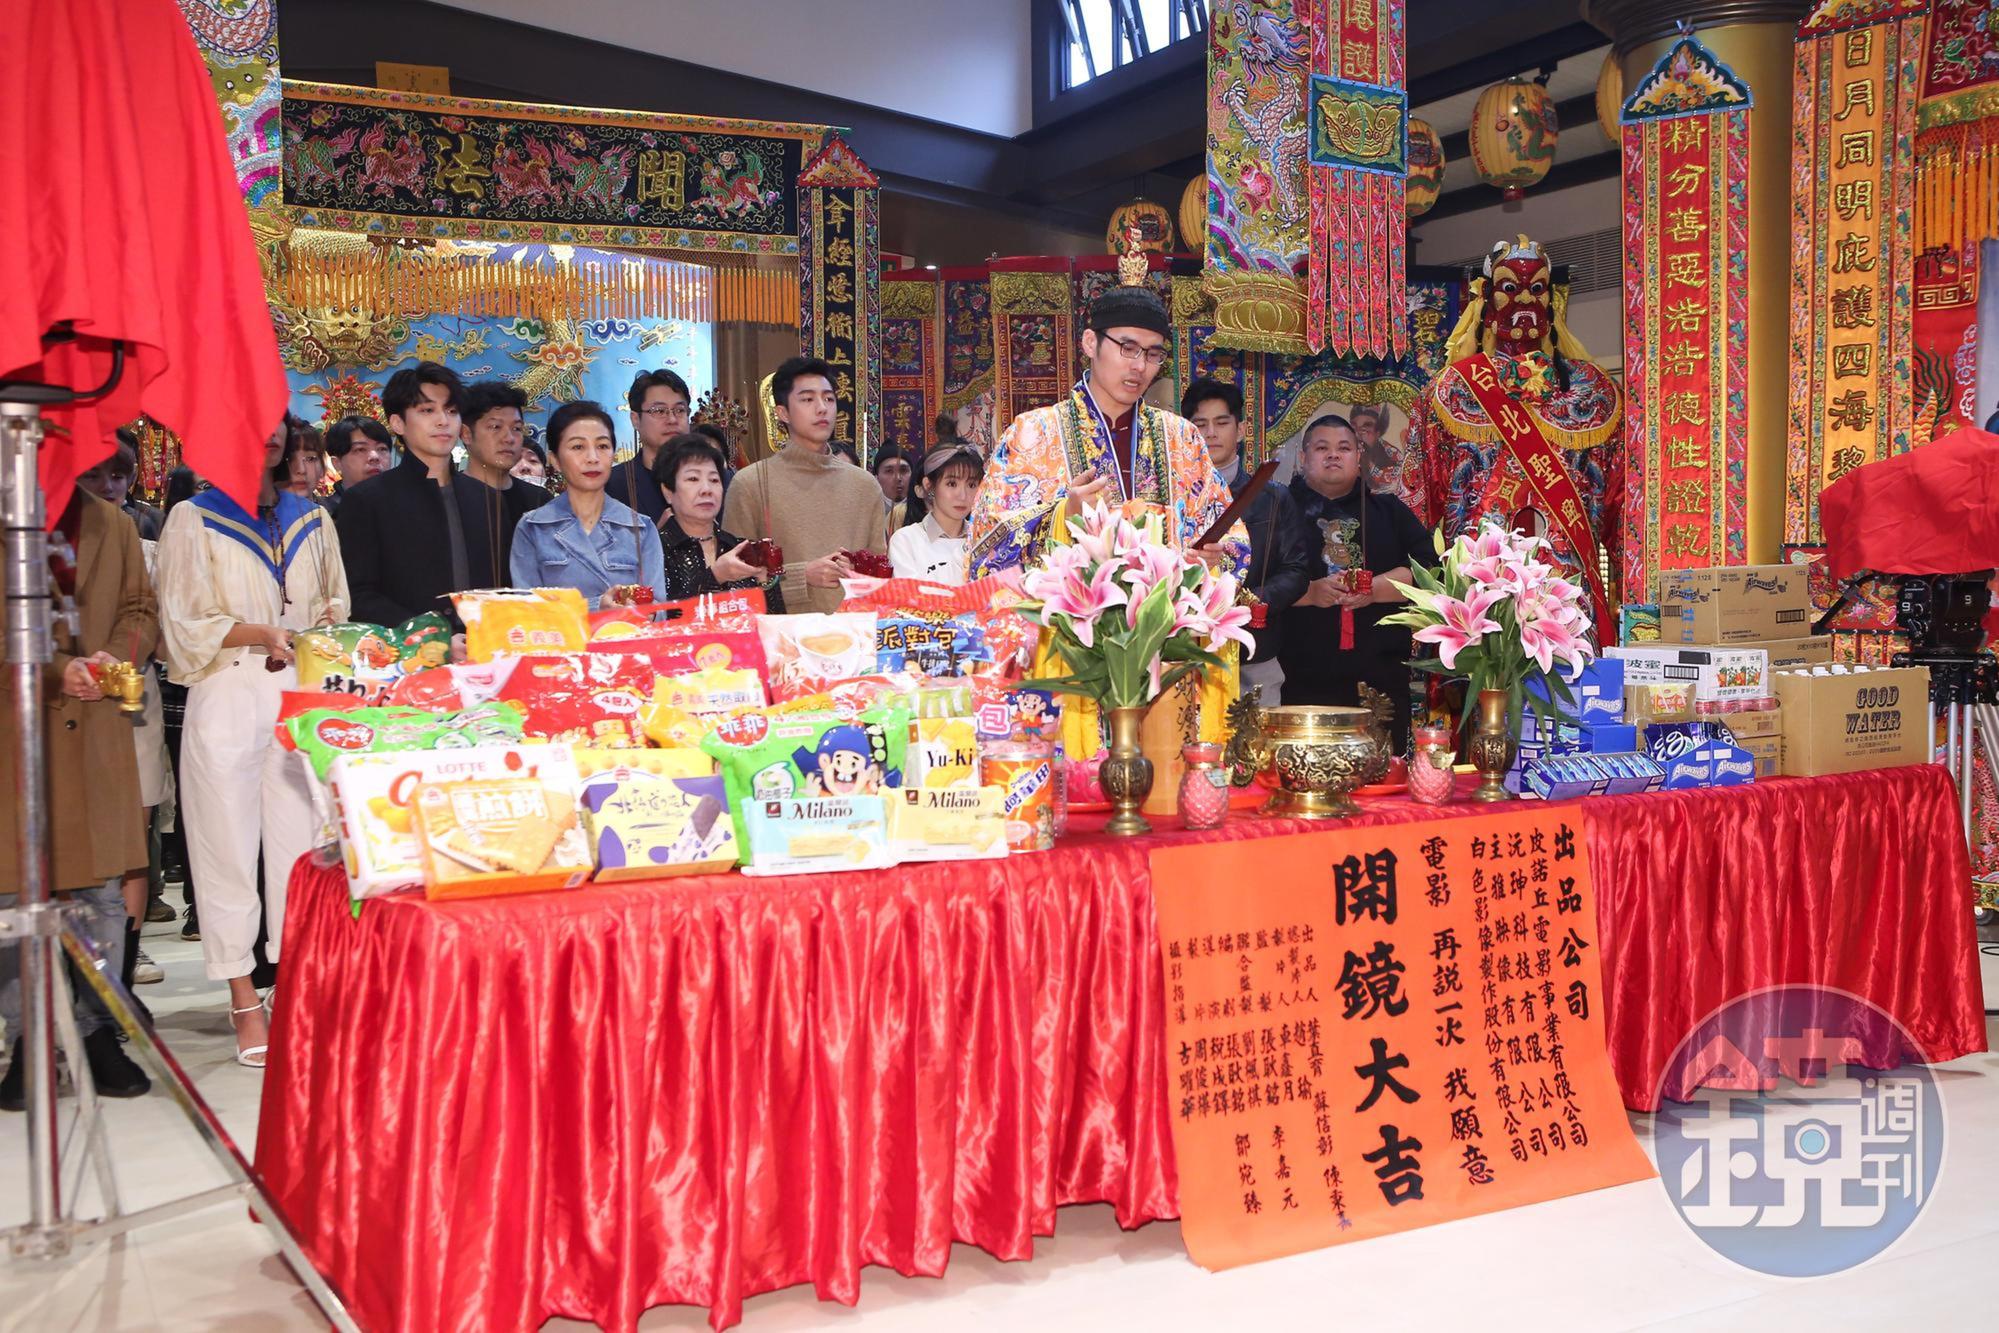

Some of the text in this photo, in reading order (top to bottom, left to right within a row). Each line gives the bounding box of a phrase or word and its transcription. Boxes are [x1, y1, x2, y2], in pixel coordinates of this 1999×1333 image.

[1661, 120, 1707, 569] 精分善惡浩浩德性證乾
[877, 625, 958, 652] 派對包
[1845, 710, 1901, 735] WATER
[1855, 685, 1900, 709] GOOD
[718, 715, 766, 737] 乖乖
[436, 761, 487, 775] LOTTE
[927, 748, 974, 768] Yu-Ki
[787, 801, 854, 820] Milano
[923, 790, 981, 809] Milano
[1554, 823, 1589, 1021] 出品公司
[1254, 930, 1273, 1013] 監製
[1302, 924, 1319, 1002] 出品人
[1529, 828, 1588, 1148] 皮諾丘電影事業有限公司
[1420, 835, 1495, 1185] 電影 再說一次 我願意
[1470, 836, 1528, 1162] 白色影像製作股份有限公司
[1332, 847, 1427, 1207] 開鏡大吉
